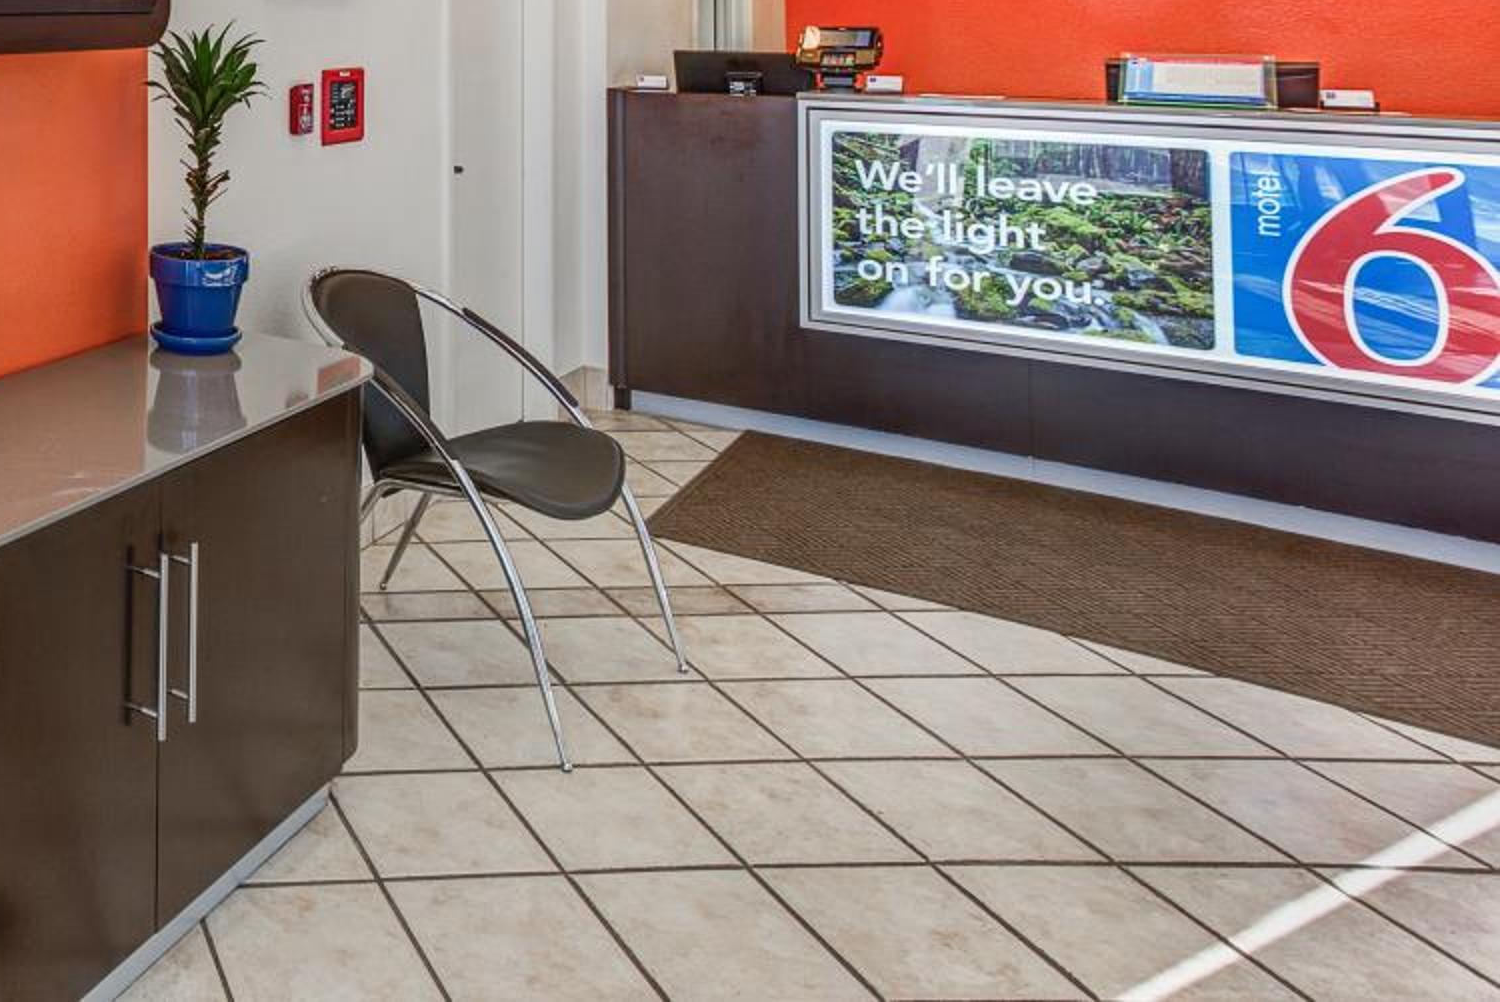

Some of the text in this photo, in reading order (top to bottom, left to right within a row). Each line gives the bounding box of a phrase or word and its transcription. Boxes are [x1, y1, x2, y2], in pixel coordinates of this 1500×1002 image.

[855, 159, 1098, 205] We'll leave
[855, 203, 1046, 255] the light
[857, 255, 1105, 307] on for you.
[1253, 166, 1500, 387] motel 6
